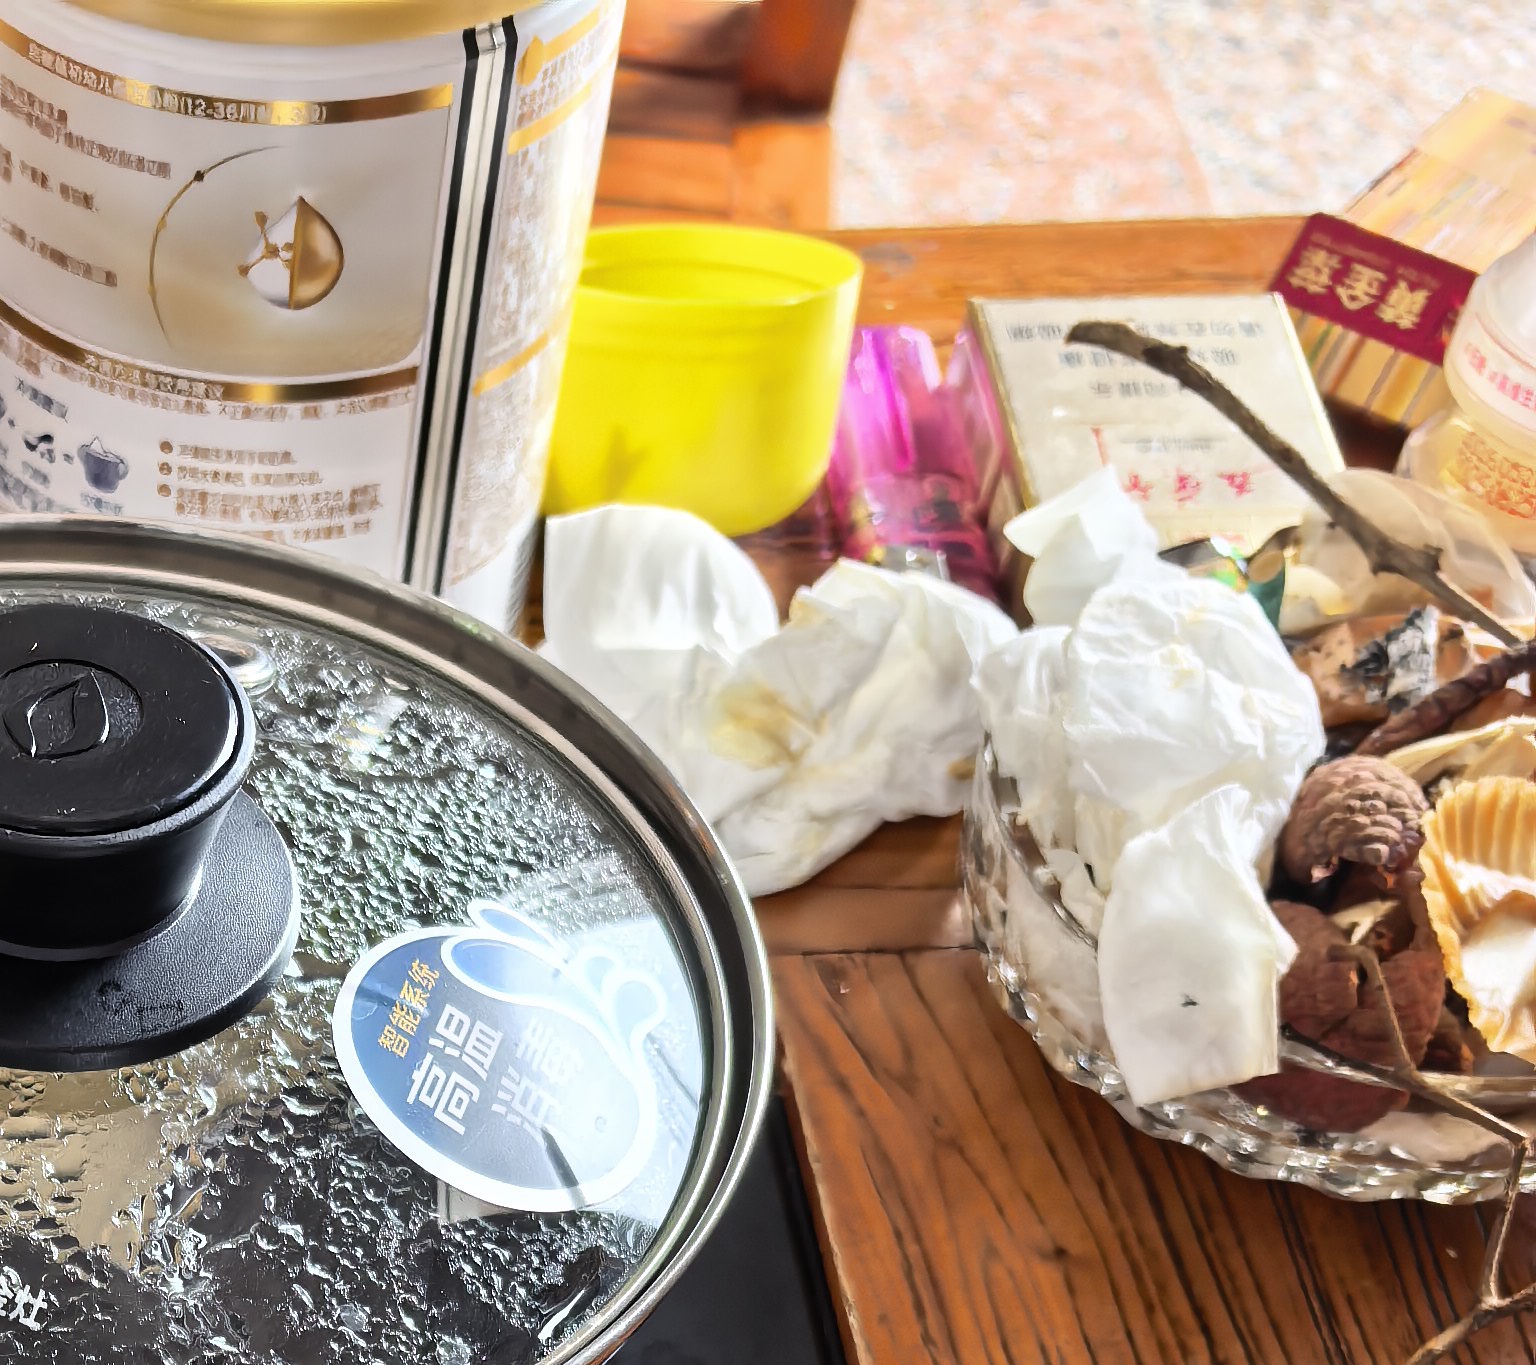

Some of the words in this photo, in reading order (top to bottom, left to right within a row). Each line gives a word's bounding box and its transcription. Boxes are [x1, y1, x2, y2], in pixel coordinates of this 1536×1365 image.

[377, 957, 441, 1060] 智能系统
[407, 1003, 505, 1136] 高温
